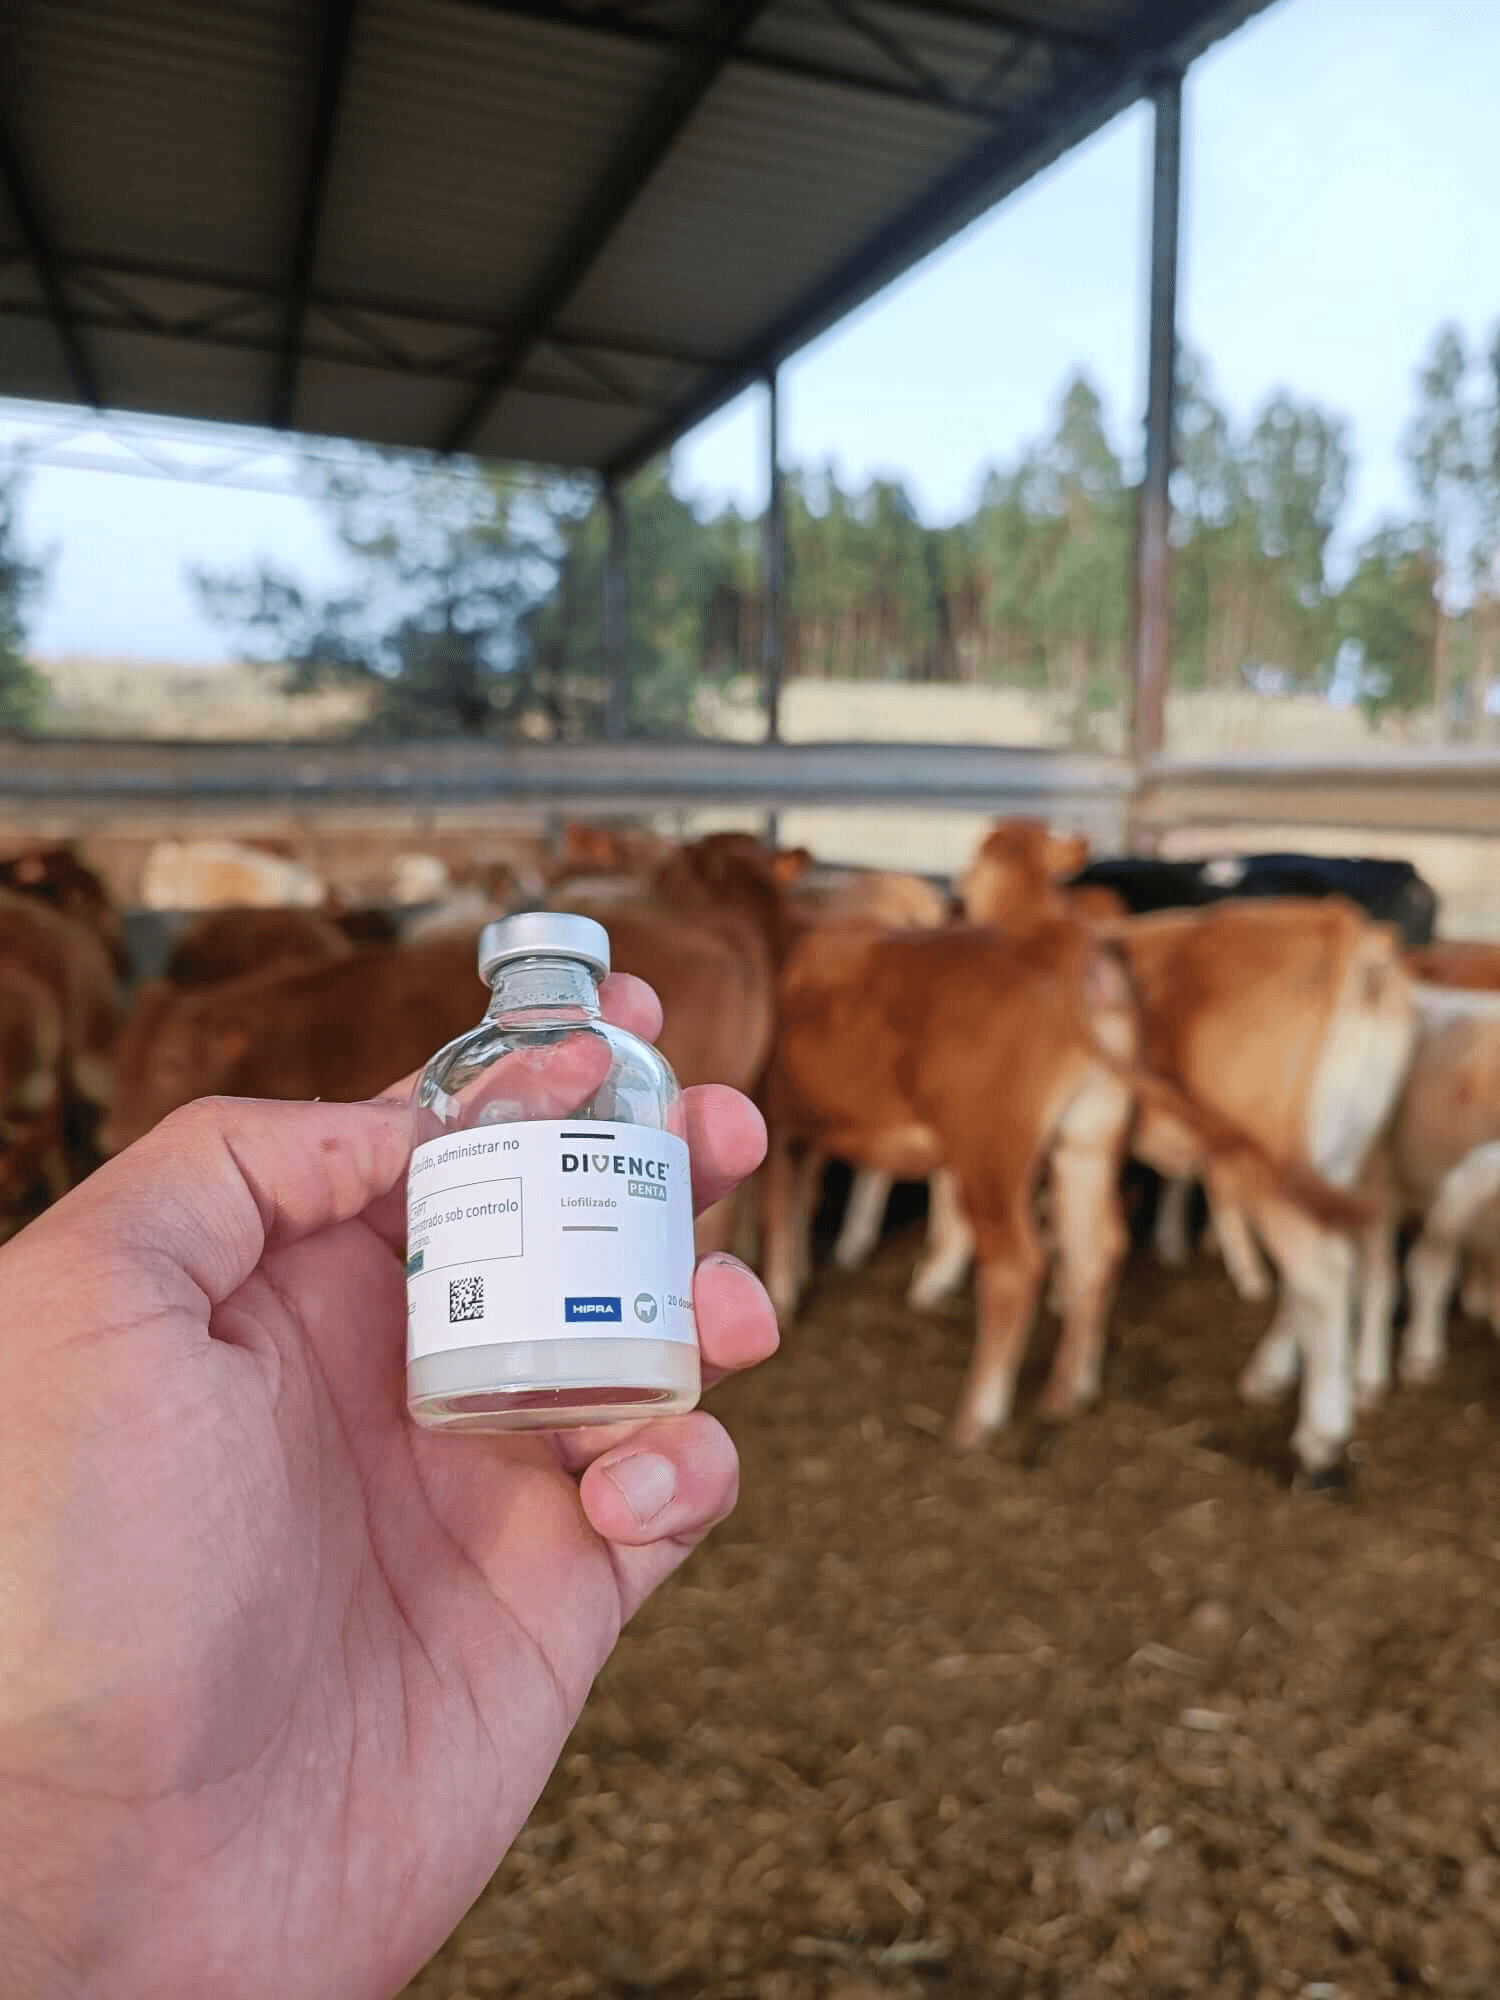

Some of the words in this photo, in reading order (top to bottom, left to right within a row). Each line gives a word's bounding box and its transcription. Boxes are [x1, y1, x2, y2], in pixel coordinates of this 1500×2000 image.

[437, 1141, 500, 1165] administrar
[503, 1138, 520, 1151] no
[562, 1153, 667, 1181] DIVENCE
[630, 1182, 666, 1199] PENTA
[445, 1207, 464, 1222] sob
[466, 1199, 519, 1219] controlo
[560, 1197, 617, 1208] Liofilizado
[572, 1303, 615, 1314] HIPRA
[668, 1296, 678, 1306] 20
